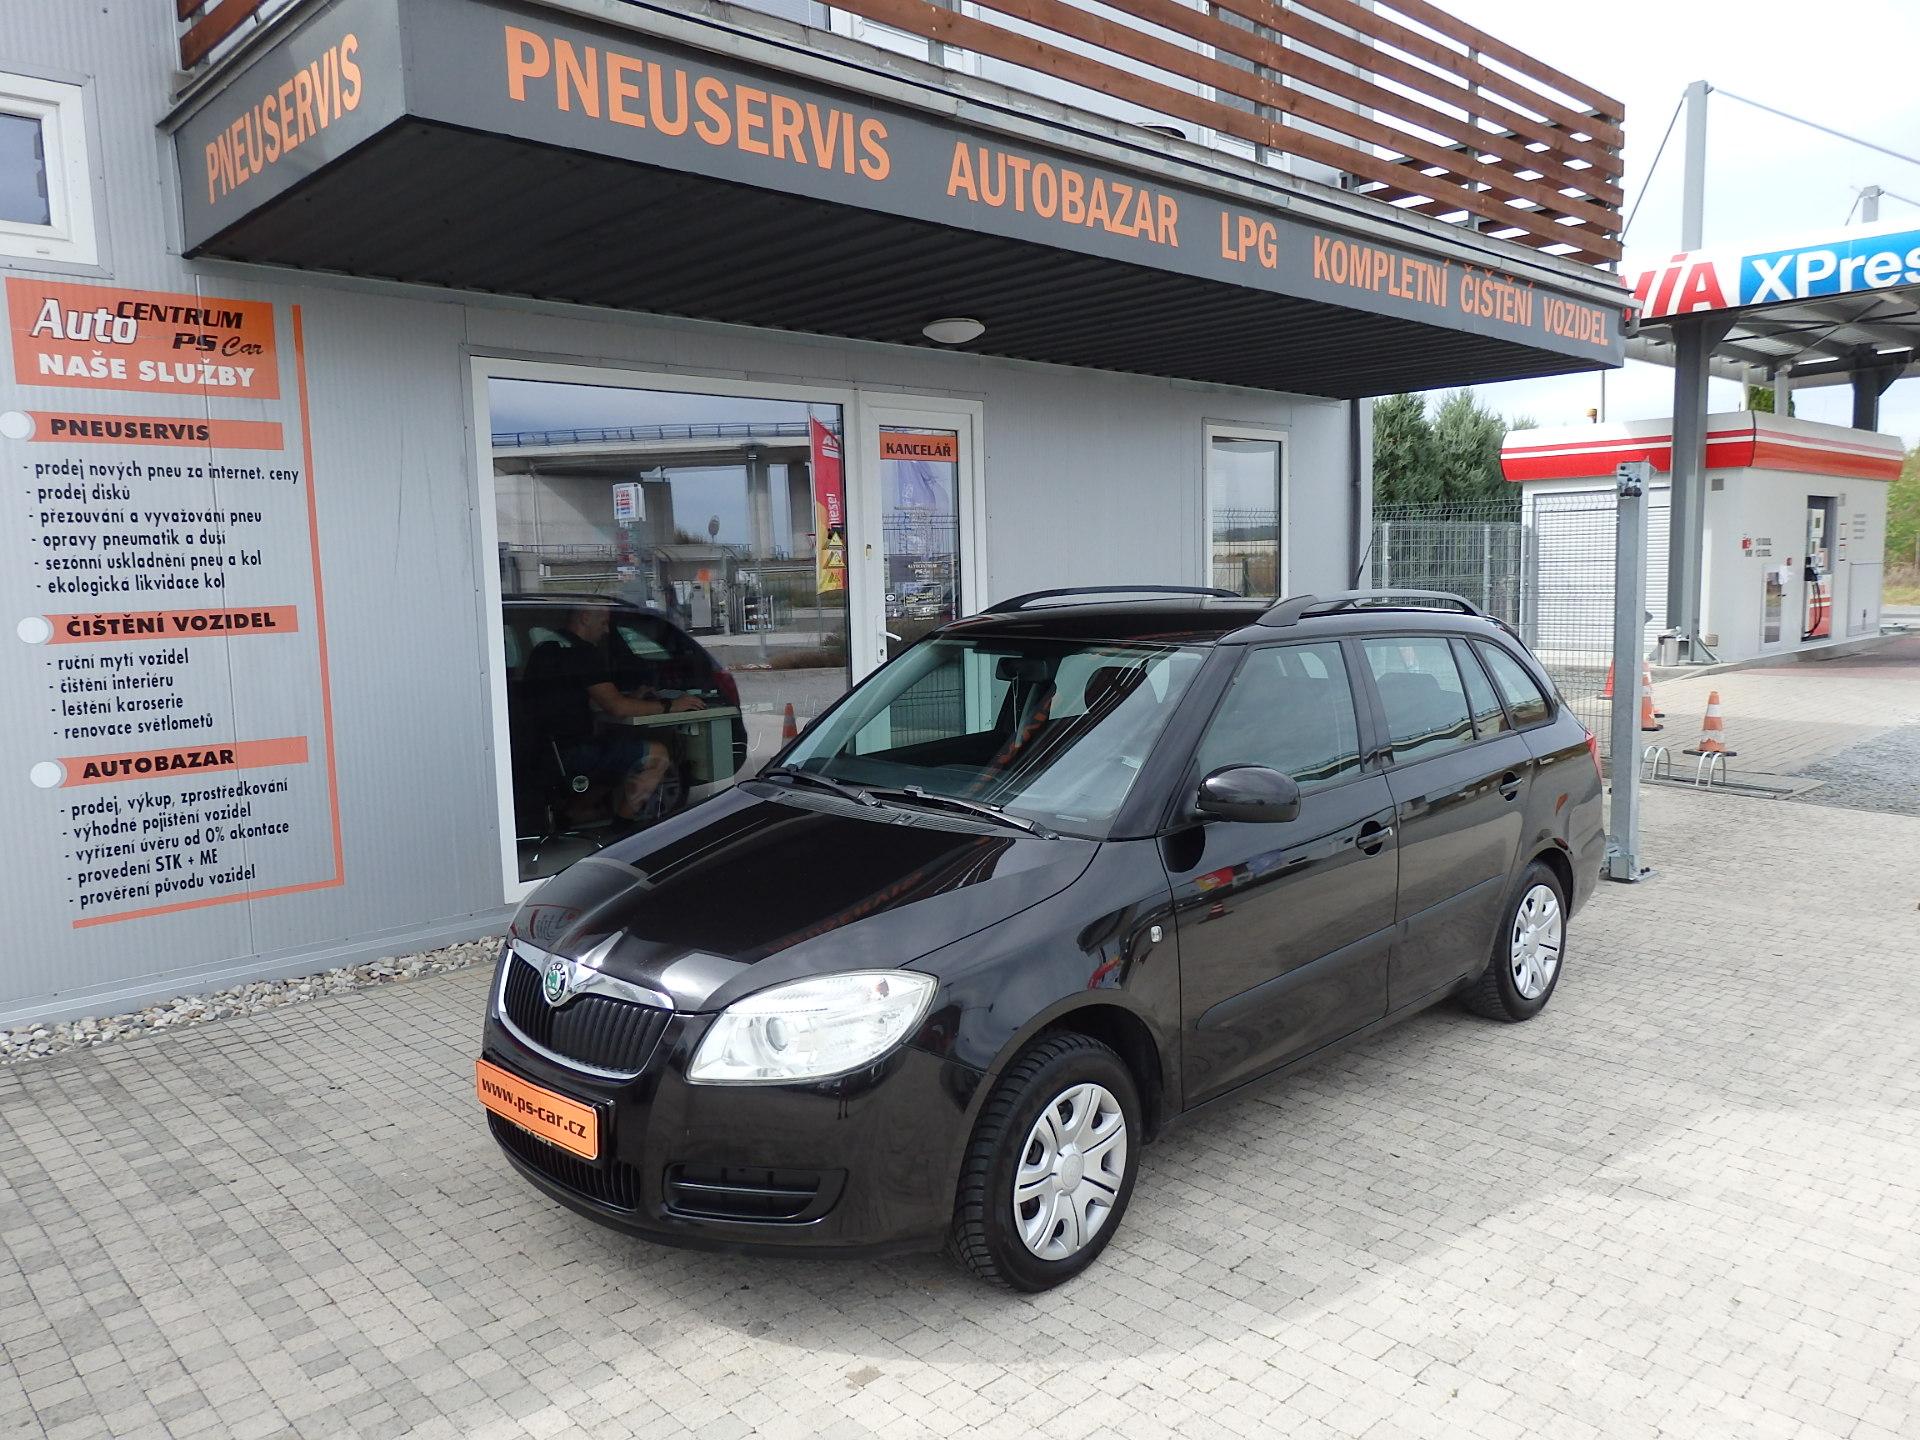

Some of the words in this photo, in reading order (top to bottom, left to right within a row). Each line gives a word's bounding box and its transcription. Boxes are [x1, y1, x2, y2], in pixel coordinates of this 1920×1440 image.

[206, 33, 362, 205] PNEUSERVIS
[504, 25, 892, 182] PNEUSERVIS
[946, 141, 1179, 248] AUTOBAZAR
[1221, 211, 1279, 269] LPG
[1313, 235, 1451, 308] KOMPLETNÍ
[1459, 262, 1534, 327] ČIŠTĚNÍ
[1543, 296, 1609, 346] VOZIDEL
[29, 297, 138, 344] Auto
[116, 301, 244, 329] CENTRUM
[172, 332, 217, 352] PS
[221, 336, 264, 357] Car
[38, 351, 127, 380] NAŠE
[139, 358, 255, 388] SLUŽBY
[51, 419, 210, 441] PNEUSERVIS
[886, 442, 951, 457] KANCELÁŘ
[35, 458, 84, 480] prodej
[89, 461, 141, 481] nových
[148, 466, 181, 481] pneu
[187, 467, 202, 478] za
[209, 462, 265, 480] internet.
[269, 468, 299, 484] ceny
[38, 485, 86, 503] prodej
[92, 484, 130, 500] disků
[41, 509, 124, 527] přezouvání
[130, 511, 138, 523] a
[144, 510, 224, 527] vyvažování
[230, 511, 262, 526] pneu
[43, 532, 96, 550] opravy
[103, 529, 179, 550] pneumatik
[186, 533, 193, 545] a
[199, 529, 226, 545] duší
[46, 554, 101, 570] sezónní
[107, 552, 185, 568] uskladnění
[191, 554, 222, 568] pneu
[228, 554, 236, 565] a
[242, 549, 263, 565] kol
[48, 576, 129, 596] ekologická
[135, 574, 199, 591] likvidace
[204, 572, 225, 588] kol
[67, 612, 164, 637] ČIŠTĚNÍ
[172, 613, 275, 631] VOZIDEL
[58, 655, 94, 670] ruční
[100, 652, 133, 670] mytí
[139, 648, 188, 665] vozidel
[61, 677, 107, 693] čištění
[112, 674, 173, 690] interiéru
[62, 699, 111, 716] leštění
[117, 695, 183, 712] karoserie
[65, 722, 132, 739] renovace
[138, 713, 213, 734] světlometů
[83, 749, 234, 778] AUTOBAZAR
[71, 798, 122, 820] prodej,
[128, 792, 175, 811] výkup,
[181, 778, 288, 804] zprostředkování
[74, 819, 137, 841] výhodné
[143, 811, 199, 834] pojištění
[204, 803, 251, 821] vozidel
[76, 843, 135, 863] vyřízení
[140, 836, 179, 852] úvěru
[184, 832, 200, 847] od
[205, 827, 225, 843] 0%
[230, 822, 289, 840] akontace
[78, 863, 150, 887] provedení
[156, 853, 182, 872] STK
[200, 849, 218, 864] ME
[80, 885, 150, 909] prověření
[155, 875, 204, 897] původu
[209, 864, 256, 885] vozidel
[482, 1078, 587, 1139] www.ps-car.cz
